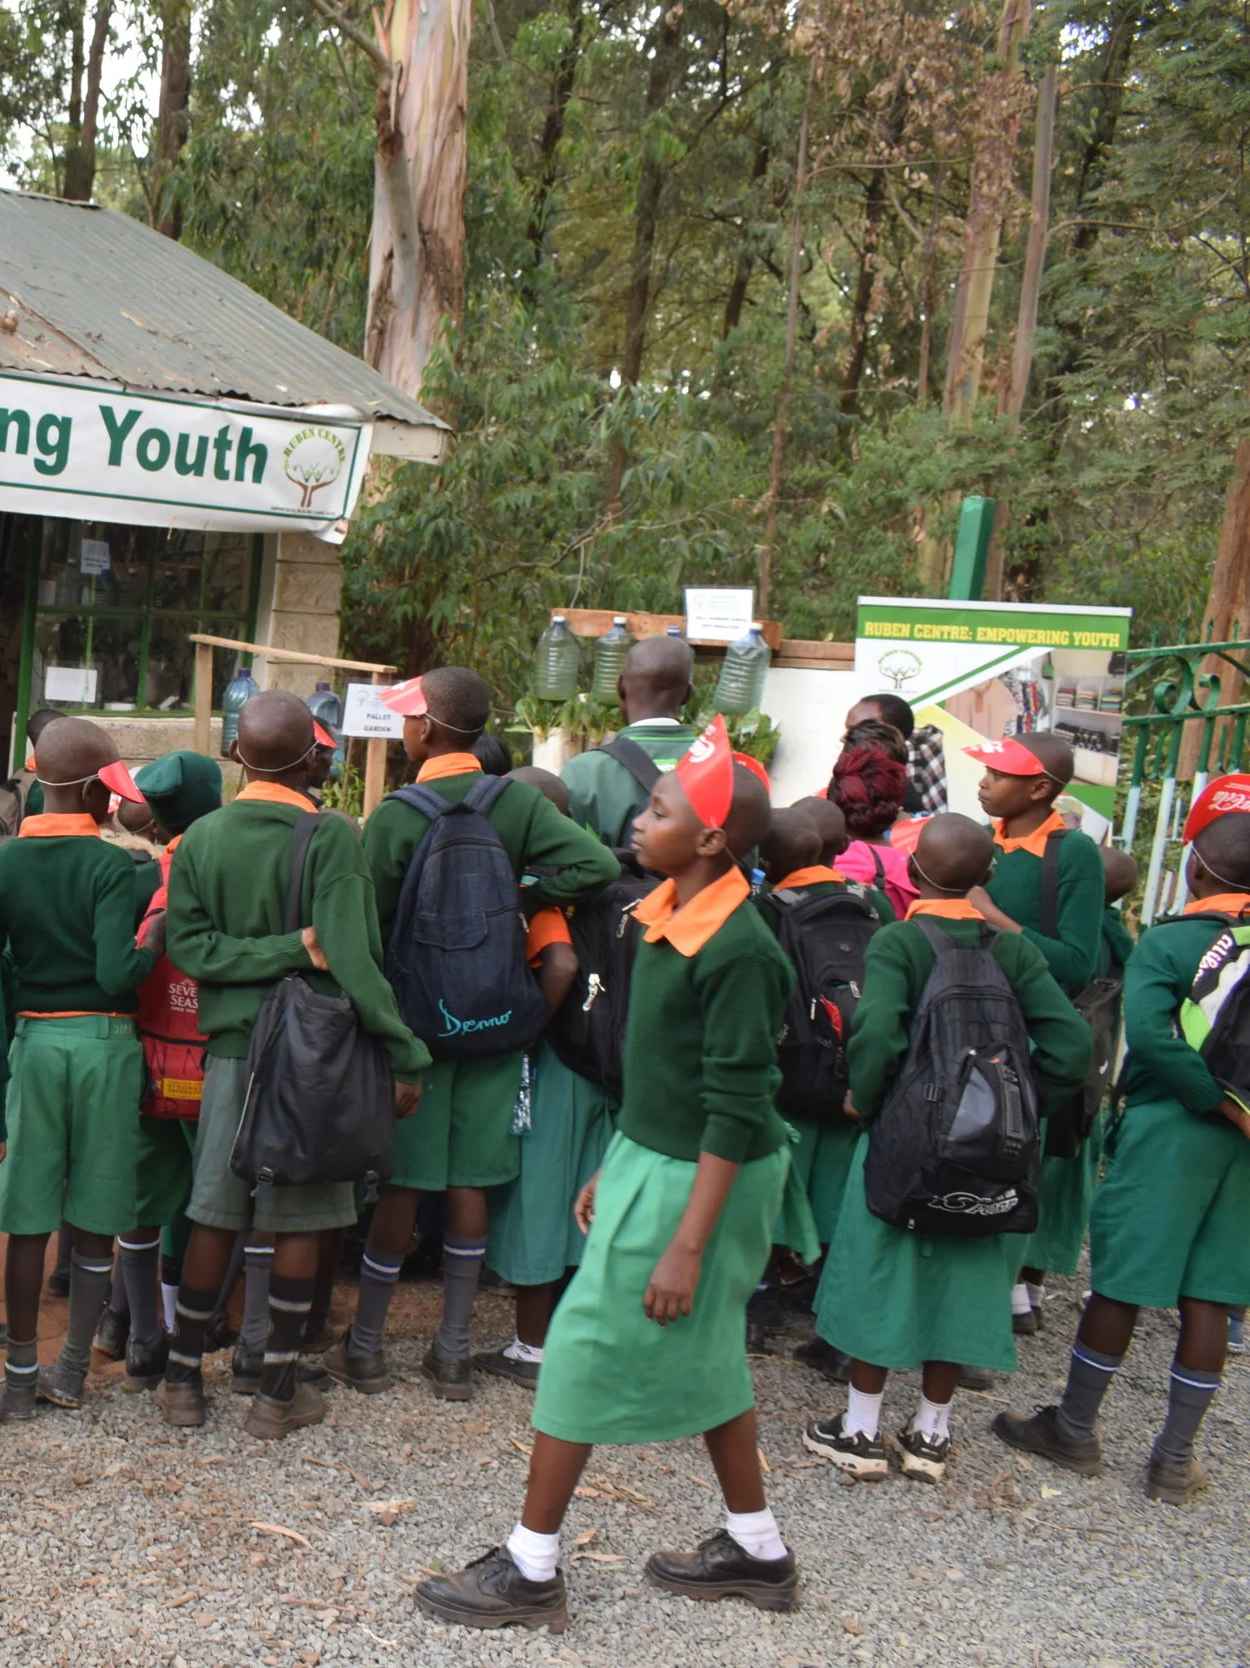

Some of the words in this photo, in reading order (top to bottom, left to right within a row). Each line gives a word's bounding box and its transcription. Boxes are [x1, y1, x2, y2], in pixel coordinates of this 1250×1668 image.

[100, 404, 269, 485] Youth
[283, 427, 315, 457] RUBEN
[318, 427, 346, 462] CENTRE
[864, 621, 911, 638] RUBEN
[913, 624, 973, 641] CENTRE:
[976, 626, 1070, 646] EMPOWERING
[1072, 631, 1120, 648] YOUTH
[366, 713, 391, 721] PALLET
[363, 725, 392, 733] GARDEN
[168, 982, 198, 998] SEVE
[170, 995, 199, 1009] SEAS
